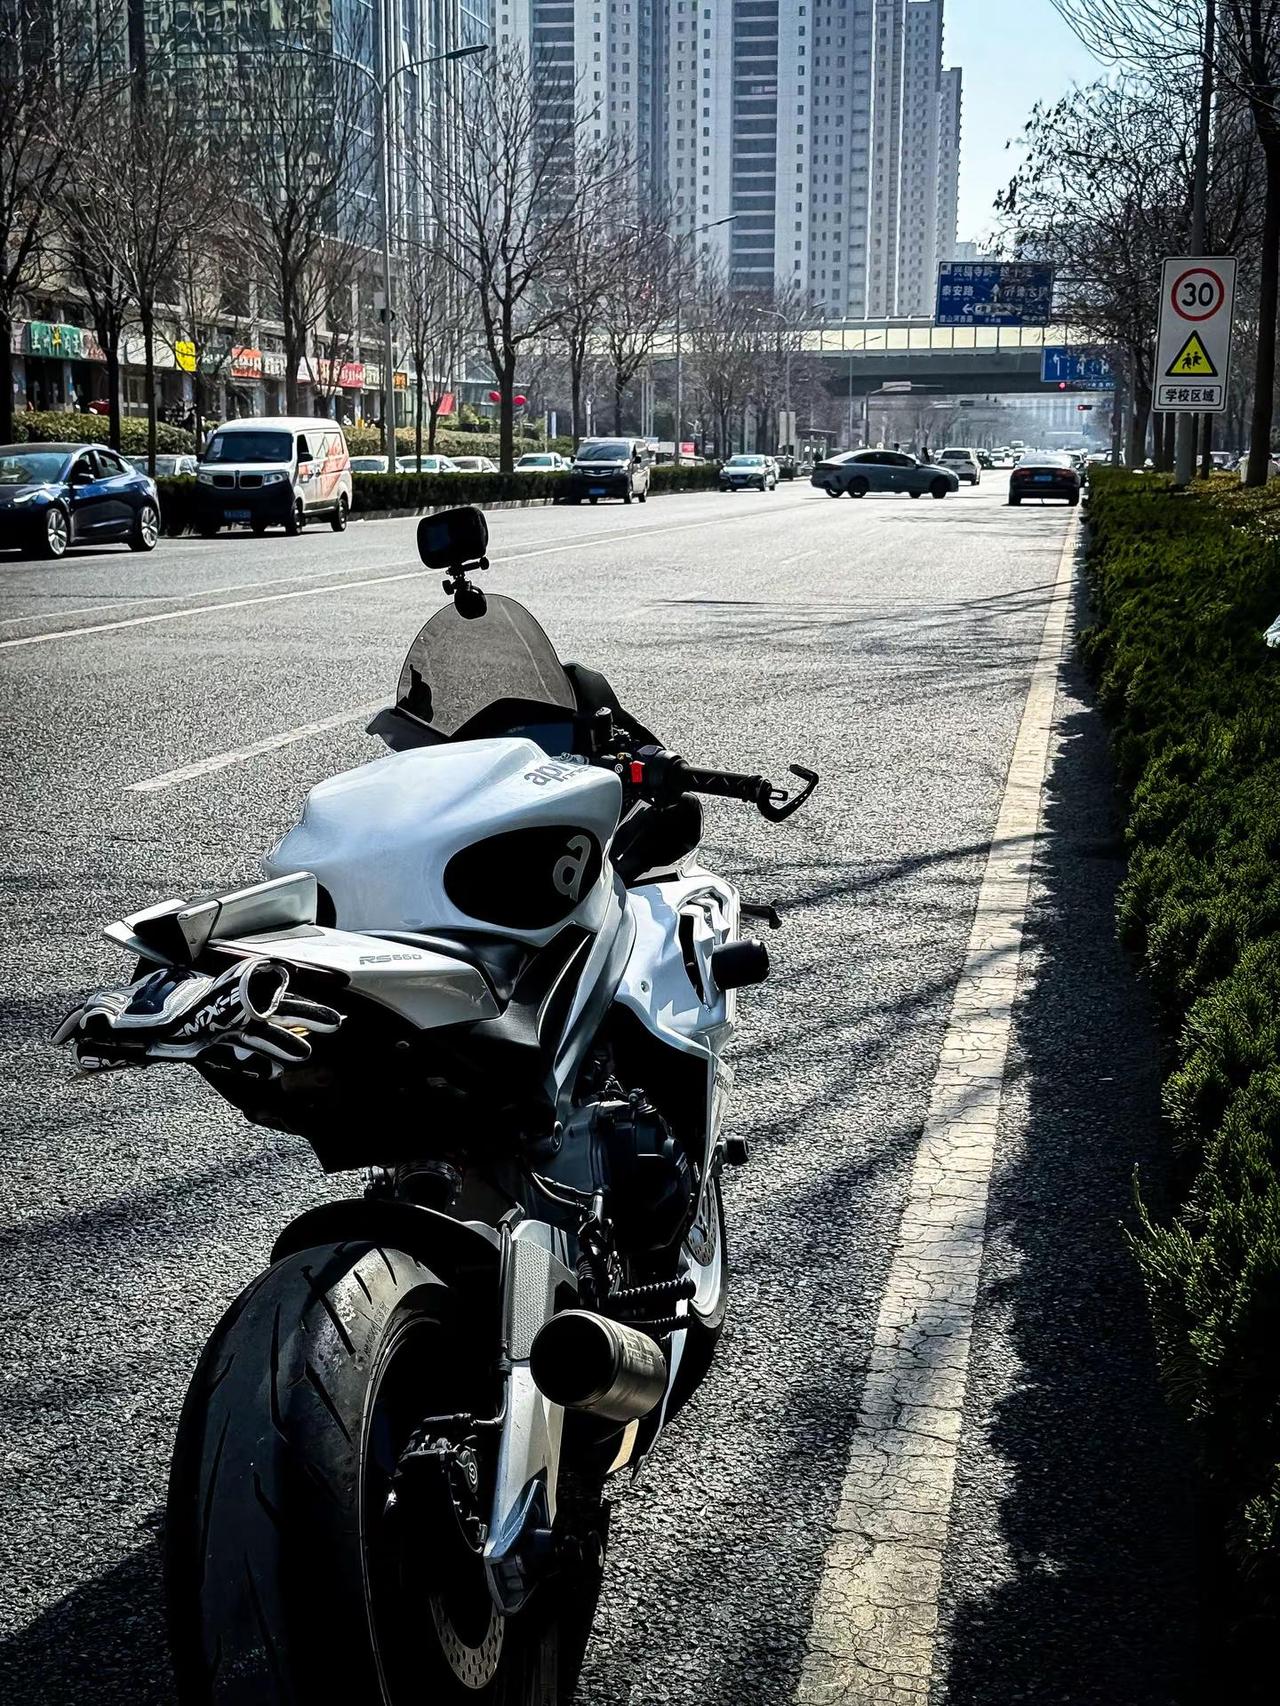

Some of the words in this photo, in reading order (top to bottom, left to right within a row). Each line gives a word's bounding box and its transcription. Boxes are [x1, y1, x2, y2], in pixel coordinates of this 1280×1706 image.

[942, 284, 974, 297] 泰安路
[1181, 282, 1214, 307] 30
[1165, 388, 1215, 403] 学校区域
